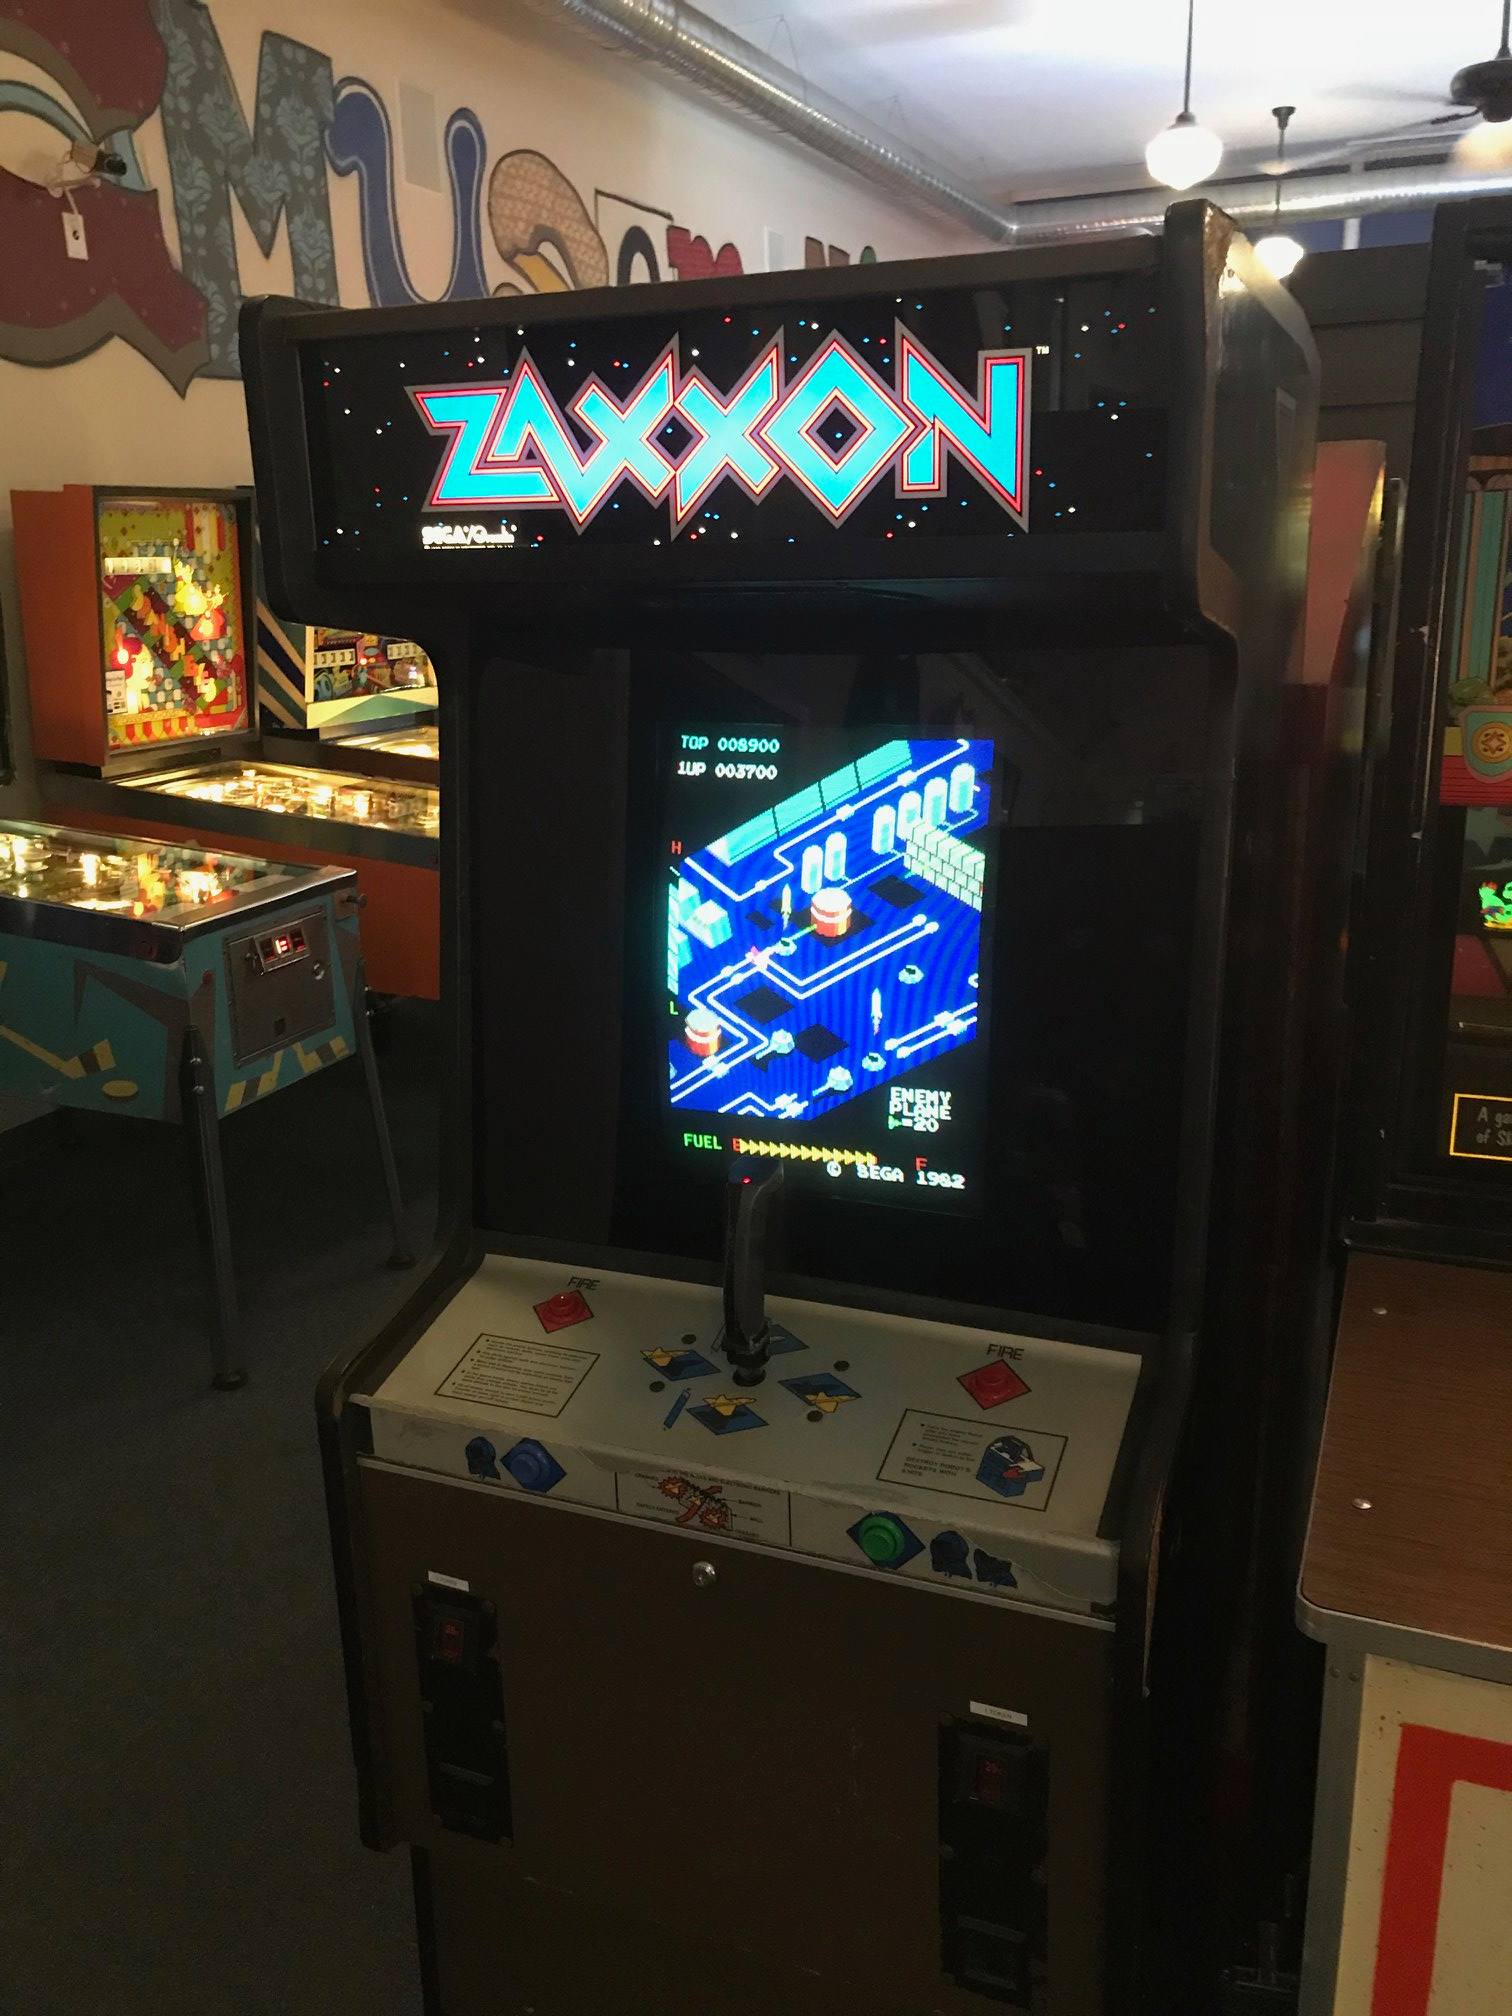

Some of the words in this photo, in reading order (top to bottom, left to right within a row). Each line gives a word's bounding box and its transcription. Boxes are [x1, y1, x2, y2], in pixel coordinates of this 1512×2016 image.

[403, 316, 1032, 540] ZAXXON
[681, 735, 709, 750] TOP
[677, 761, 707, 776] 1UP
[714, 763, 778, 780] 003700
[671, 840, 682, 855] H
[890, 1086, 952, 1104] ENEMY
[889, 1101, 952, 1120] PLANE
[683, 1133, 722, 1150] FUEL
[915, 1156, 927, 1171] F
[856, 1164, 905, 1183] SEGA
[568, 1277, 600, 1291] FIRE
[986, 1344, 1025, 1360] FIRE
